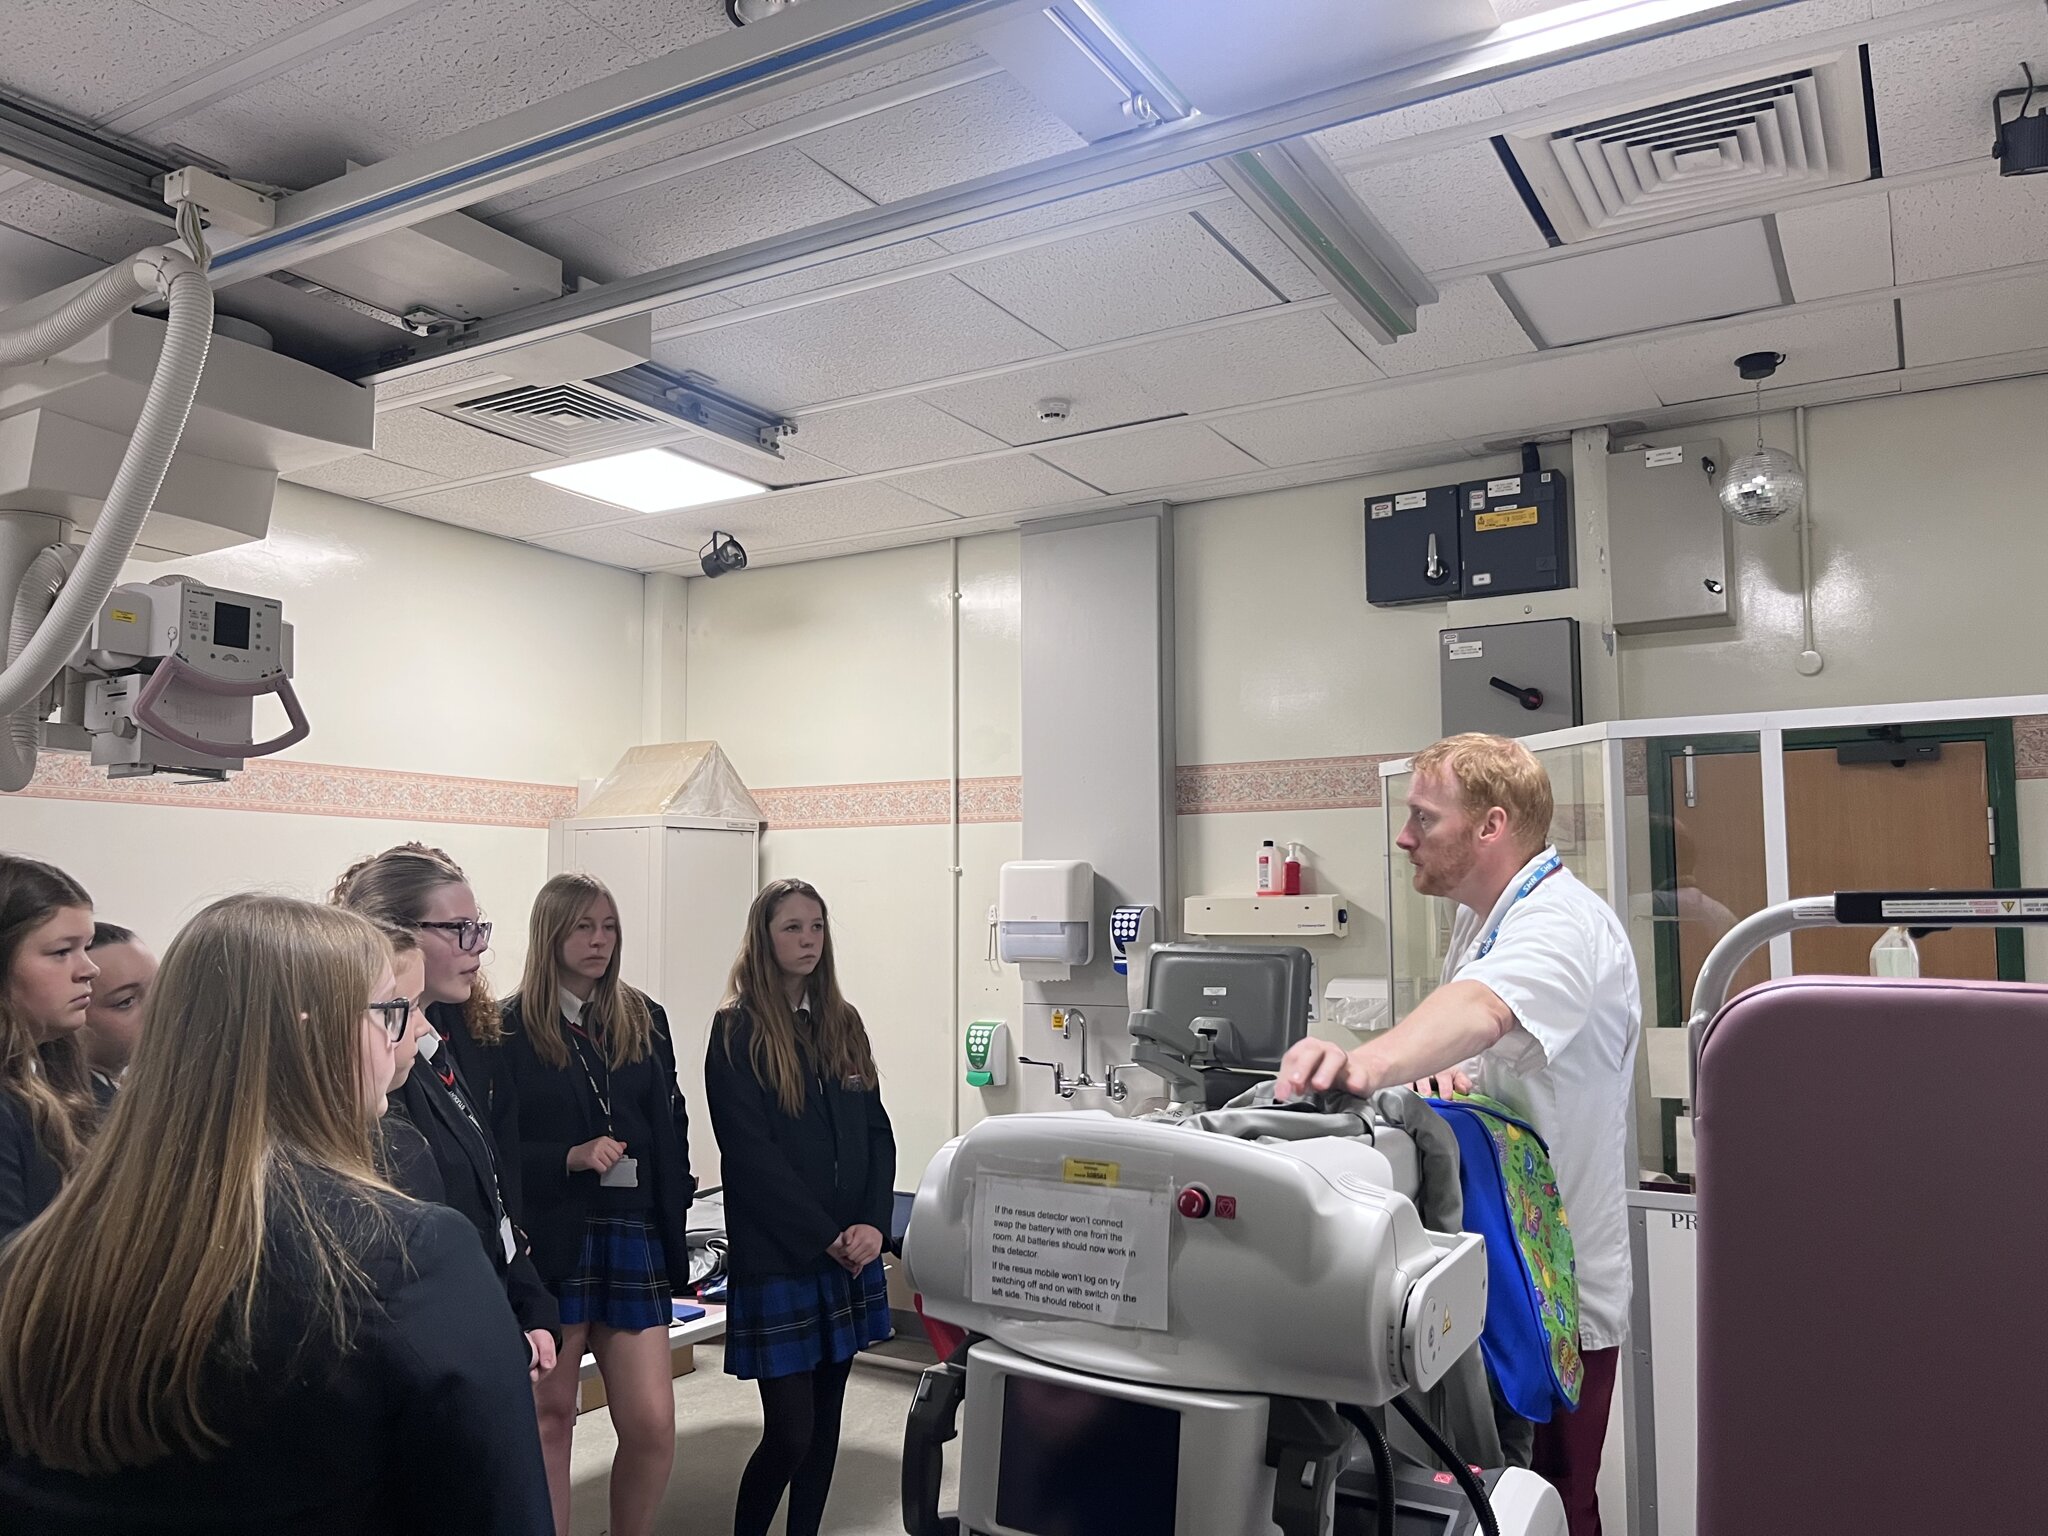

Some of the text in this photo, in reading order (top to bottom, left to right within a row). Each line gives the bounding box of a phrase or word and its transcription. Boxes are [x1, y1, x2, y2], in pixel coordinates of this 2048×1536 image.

[995, 1205, 1123, 1229] If the resus detector won't connect
[994, 1220, 1123, 1242] swap the battery with one from the
[992, 1245, 1005, 1254] this
[1016, 1234, 1026, 1243] All
[1028, 1236, 1060, 1248] batteries
[1062, 1240, 1087, 1251] should
[1089, 1244, 1106, 1253] now
[1107, 1246, 1126, 1257] work
[1128, 1249, 1136, 1258] in
[992, 1261, 1120, 1289] If the resus mobile won't log on try
[992, 1275, 1137, 1303] switching off and on with switch on the
[992, 1287, 1003, 1297] left
[1024, 1291, 1040, 1303] This
[1042, 1295, 1067, 1307] should
[1069, 1300, 1094, 1311] reboot
